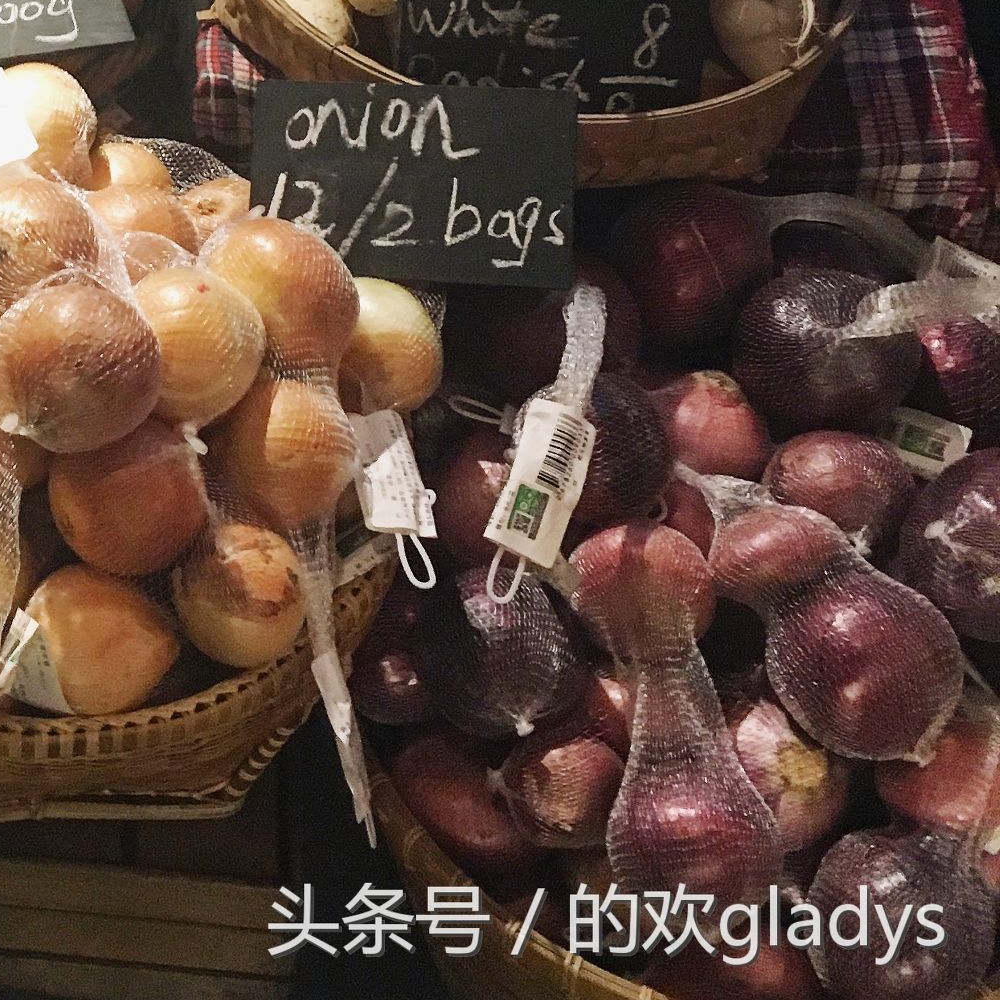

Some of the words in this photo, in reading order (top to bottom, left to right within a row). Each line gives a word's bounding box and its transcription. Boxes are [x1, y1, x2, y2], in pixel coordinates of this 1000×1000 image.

[633, 3, 671, 69] 8
[286, 83, 480, 159] onion
[445, 178, 566, 268] bags
